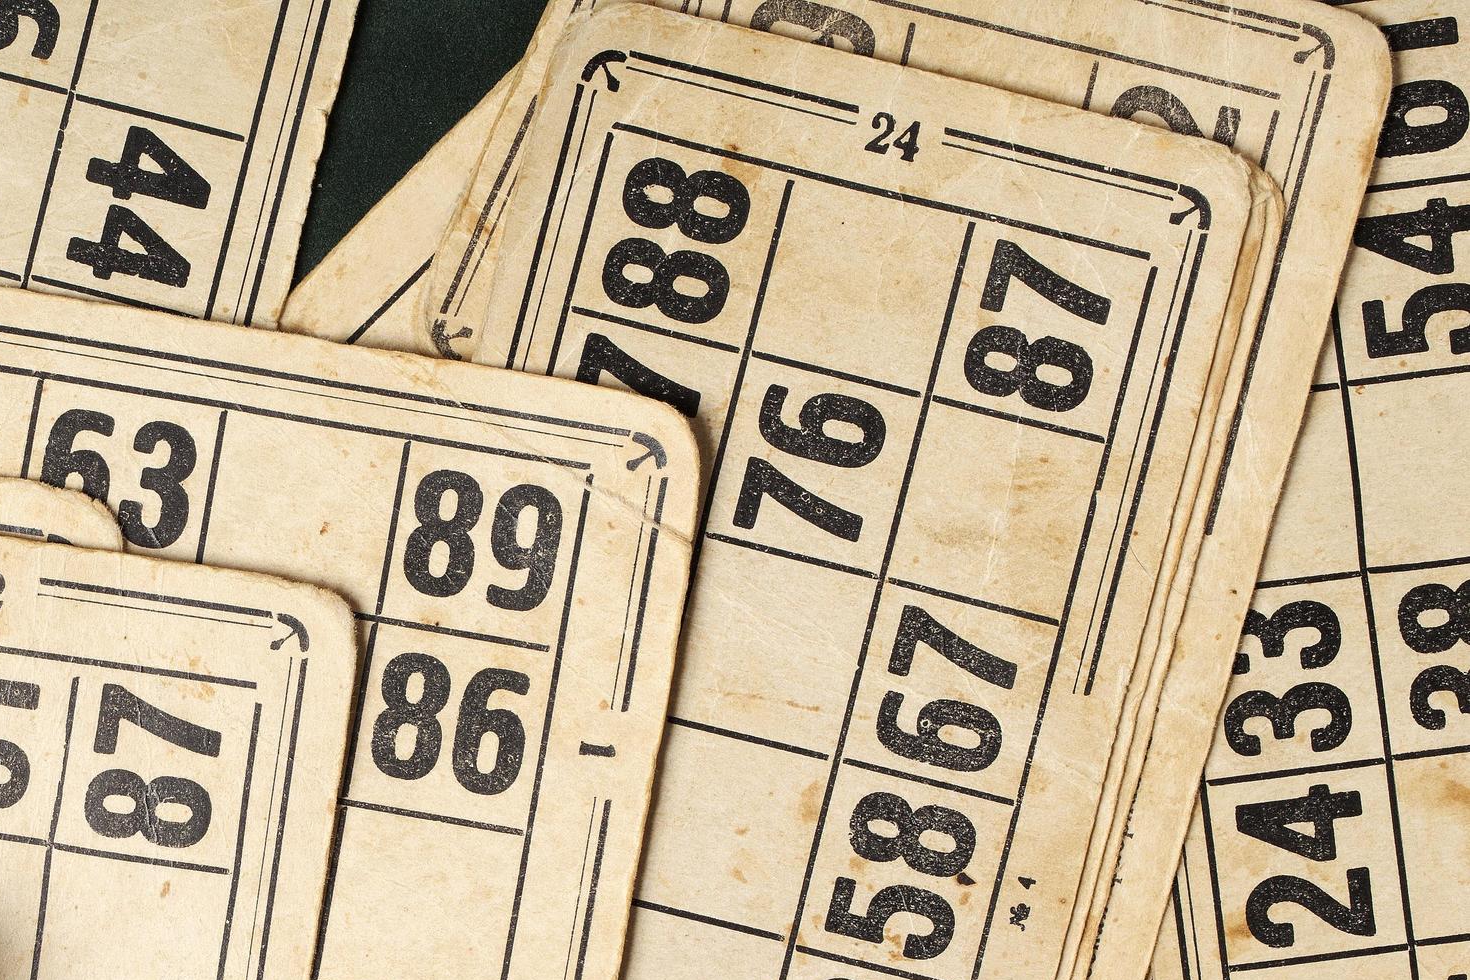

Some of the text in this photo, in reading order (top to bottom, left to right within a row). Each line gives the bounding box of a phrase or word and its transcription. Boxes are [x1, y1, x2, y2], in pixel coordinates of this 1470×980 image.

[67, 126, 211, 288] 44
[865, 112, 920, 162] 24
[602, 157, 750, 324] 88
[1354, 198, 1470, 358] 54
[577, 333, 701, 417] 7
[964, 239, 1110, 412] 87
[40, 408, 197, 549] 63
[404, 470, 562, 611] 89
[733, 384, 886, 542] 76
[372, 653, 529, 795] 86
[877, 605, 1017, 772] 67
[1224, 600, 1352, 757] 33
[85, 684, 221, 847] 87
[825, 792, 976, 959] 58
[1236, 784, 1376, 948] 24
